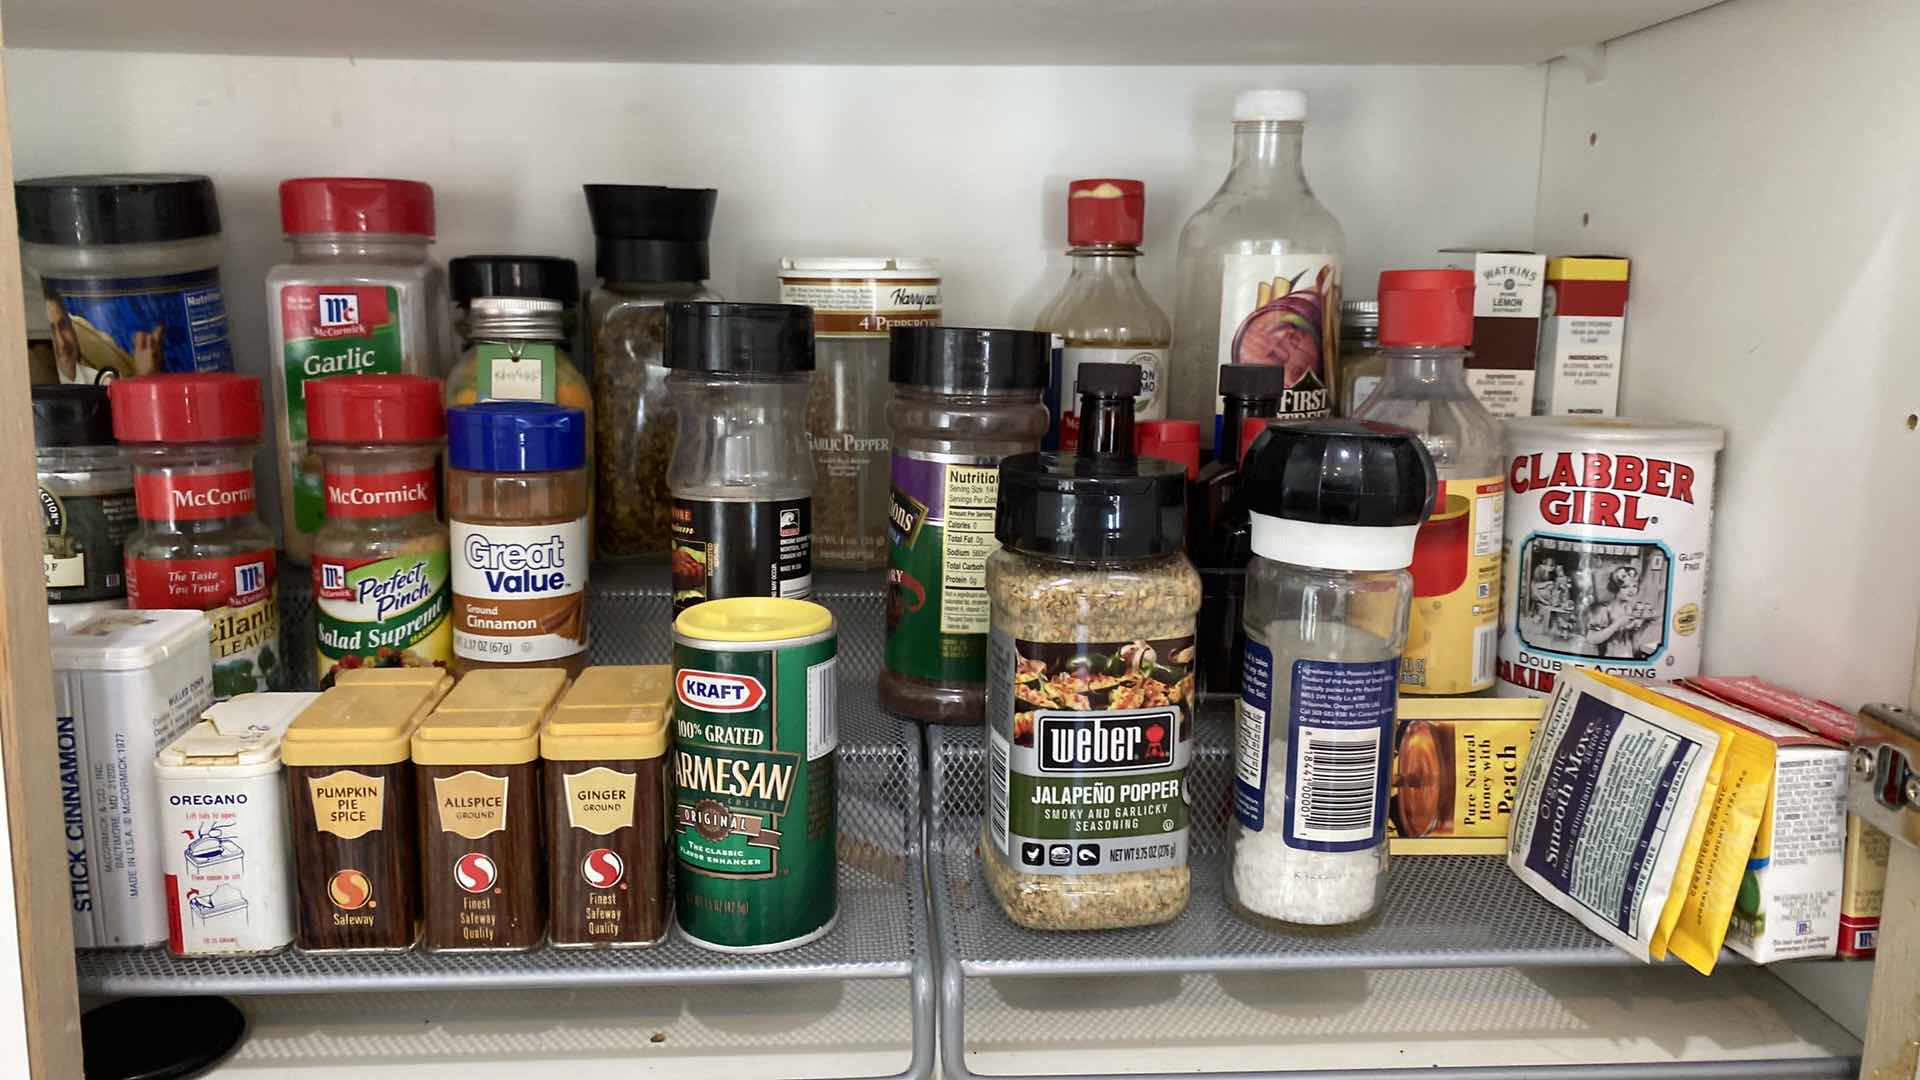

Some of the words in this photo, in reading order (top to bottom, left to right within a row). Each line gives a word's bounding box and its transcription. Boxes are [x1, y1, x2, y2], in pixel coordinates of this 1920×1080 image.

[1483, 265, 1537, 281] WATKINS
[1493, 298, 1522, 307] LEMON
[858, 316, 869, 330] 4
[303, 347, 376, 375] Garlic
[1280, 388, 1328, 413] FIRST
[805, 431, 841, 452] GARLIC
[843, 433, 889, 452] PEPPER
[1510, 452, 1695, 505] CLABBER
[328, 483, 428, 505] McCormick
[1539, 490, 1650, 531] GIRL
[948, 520, 971, 529] Calories
[947, 534, 962, 542] Total
[464, 533, 565, 570] Great
[946, 548, 970, 557] Sodium
[946, 561, 961, 570] Total
[168, 572, 187, 582] The
[190, 570, 219, 581] Taste
[358, 562, 426, 604] Perfect
[484, 571, 566, 593] Value
[945, 575, 968, 584] Protein
[168, 584, 188, 595] You
[191, 583, 220, 594] Trust
[376, 576, 429, 622] Pinch
[466, 603, 498, 615] Ground
[466, 614, 537, 630] Cinnamon
[318, 623, 362, 651] Salad
[489, 641, 512, 655] (67g)
[687, 679, 745, 701] KRAFT
[677, 719, 702, 739] 100%
[705, 724, 764, 746] GRATED
[115, 732, 126, 753] 1977
[1051, 719, 1142, 764] weber
[1463, 734, 1477, 789] Natural
[1478, 739, 1491, 771] with
[56, 716, 86, 842] CINNAMON
[1496, 745, 1517, 815] Peach
[1540, 751, 1568, 820] Organic
[169, 793, 248, 807] OREGANO
[316, 785, 378, 799] PUMPKIN
[577, 789, 627, 801] GINGER
[1031, 782, 1115, 805] JALAPEÑO
[1120, 780, 1179, 803] POPPER
[1479, 777, 1495, 821] Honey
[1545, 784, 1574, 868] Smooth
[1564, 721, 1595, 781] Move
[337, 799, 358, 811] PIE
[444, 796, 502, 809] ALLSPICE
[583, 803, 622, 812] GROUND
[1463, 794, 1477, 825] Pure
[1570, 782, 1594, 837] Stimulant
[1708, 782, 1728, 836] ORGANIC
[330, 810, 367, 823] SPICE
[456, 810, 495, 820] GROUND
[1044, 808, 1084, 820] SMOKY
[1087, 807, 1110, 819] AND
[1115, 803, 1168, 818] GARLICKY
[684, 809, 746, 831] ORIGINAL
[1075, 818, 1139, 832] SEASONING
[704, 846, 744, 858] CLASSIC
[1109, 848, 1122, 863] NET
[1123, 848, 1135, 862] WT
[127, 856, 137, 868] IN
[707, 856, 761, 866] ENHANCER
[68, 847, 93, 913] STICK
[128, 870, 139, 897] MADE
[1630, 870, 1646, 921] CAFFEINE
[1643, 845, 1656, 871] FREE
[463, 897, 491, 911] Finest
[589, 892, 617, 905] Finest
[333, 913, 375, 928] Safeway
[460, 912, 497, 926] Safeway
[585, 908, 621, 923] Safeway
[463, 926, 496, 941] Quality
[588, 922, 620, 937] Quality
